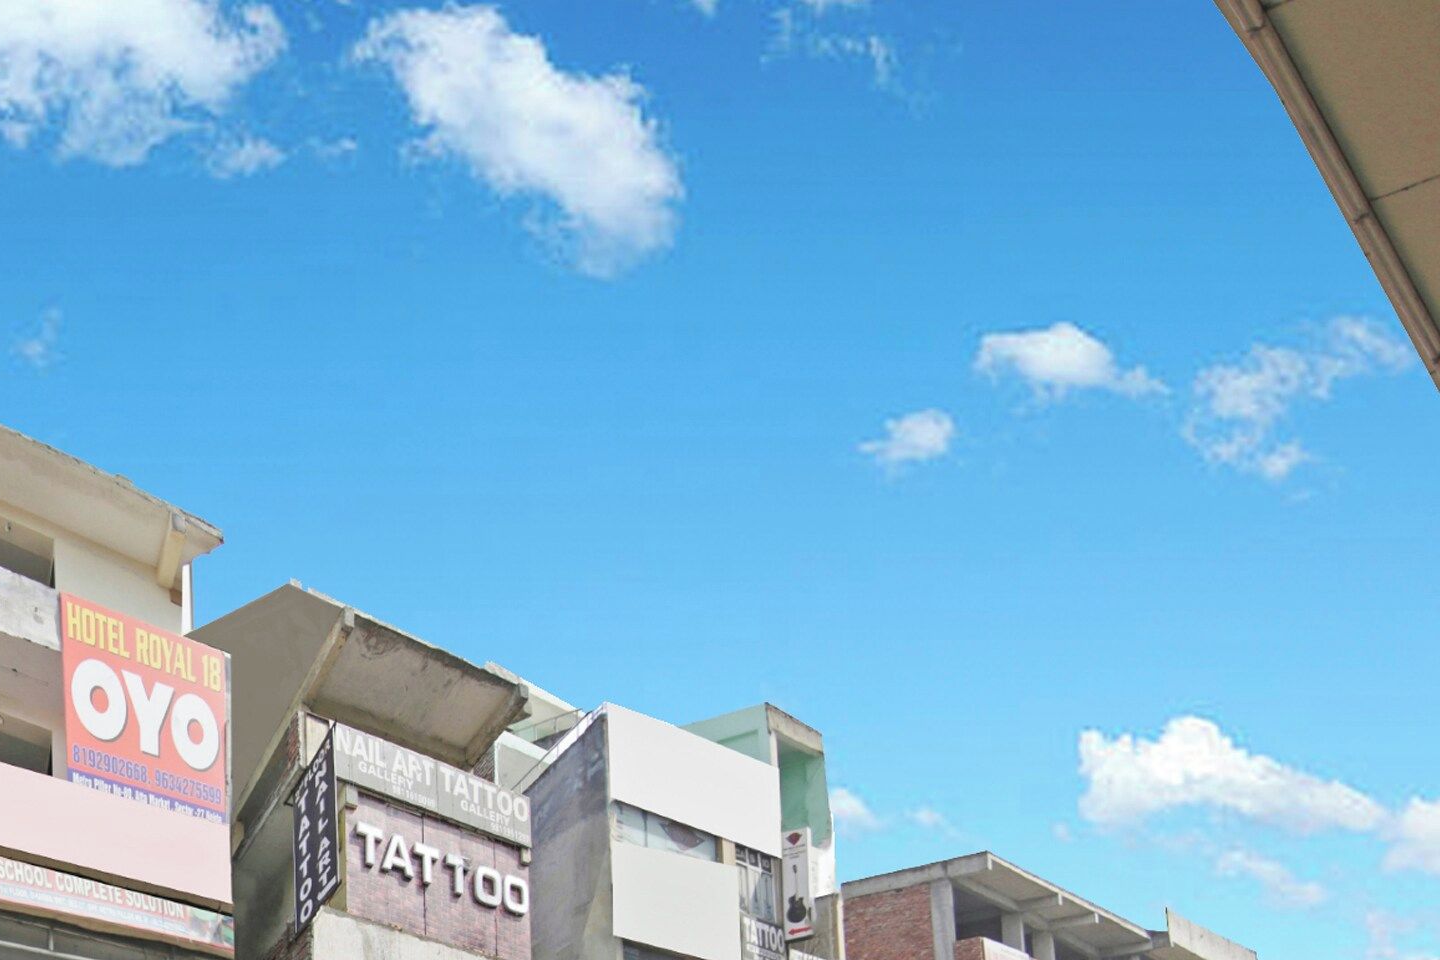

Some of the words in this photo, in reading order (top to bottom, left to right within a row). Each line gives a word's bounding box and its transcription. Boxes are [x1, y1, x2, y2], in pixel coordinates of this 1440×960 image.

[66, 601, 130, 659] HOTEL
[135, 626, 197, 683] ROYAL
[202, 654, 222, 692] 18
[71, 658, 221, 772] OYO
[154, 770, 222, 805] 9634275599
[335, 726, 387, 768] NAIL
[391, 749, 435, 786] ART
[438, 765, 529, 822] TATTOO
[359, 760, 414, 791] GALLERY
[460, 799, 510, 827] GALLERY
[297, 788, 313, 924] TATTOO
[353, 819, 529, 916] TATTOO
[56, 871, 124, 906] COMPLETE
[124, 889, 186, 920] SOLUTION
[743, 916, 785, 952] TATTOO
